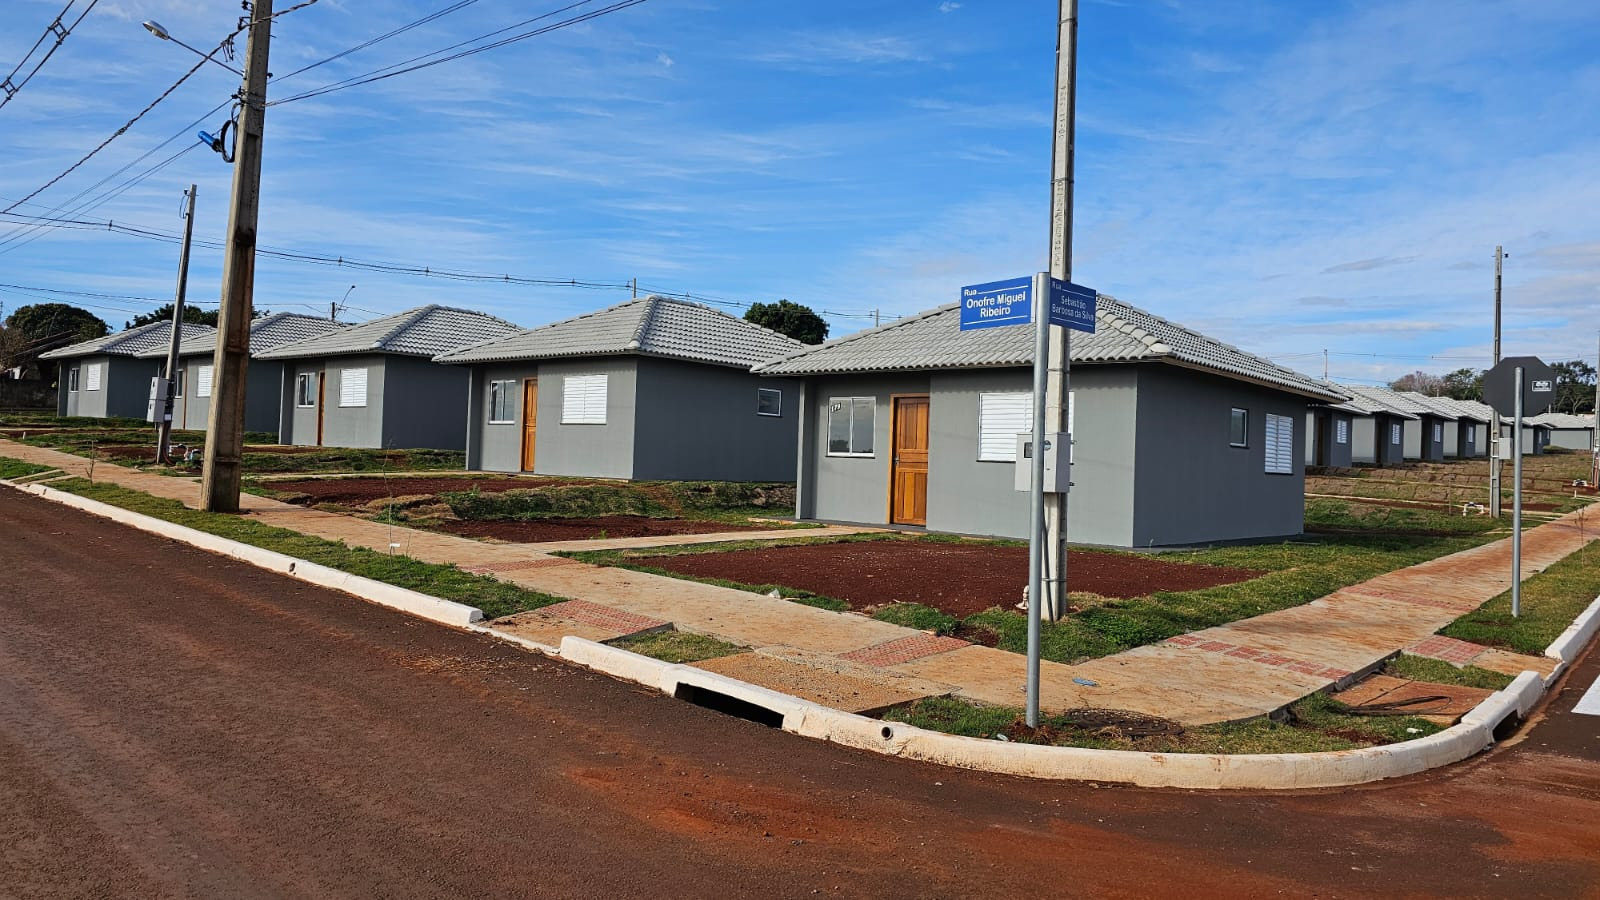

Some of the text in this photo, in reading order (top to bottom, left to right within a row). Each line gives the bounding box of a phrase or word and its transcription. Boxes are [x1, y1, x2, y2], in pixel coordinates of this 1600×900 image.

[1052, 281, 1062, 290] Rua
[966, 290, 1026, 309] Onofre Miguel
[980, 305, 1011, 318] Ribeiro
[1052, 303, 1094, 321] Barbosa da Silva
